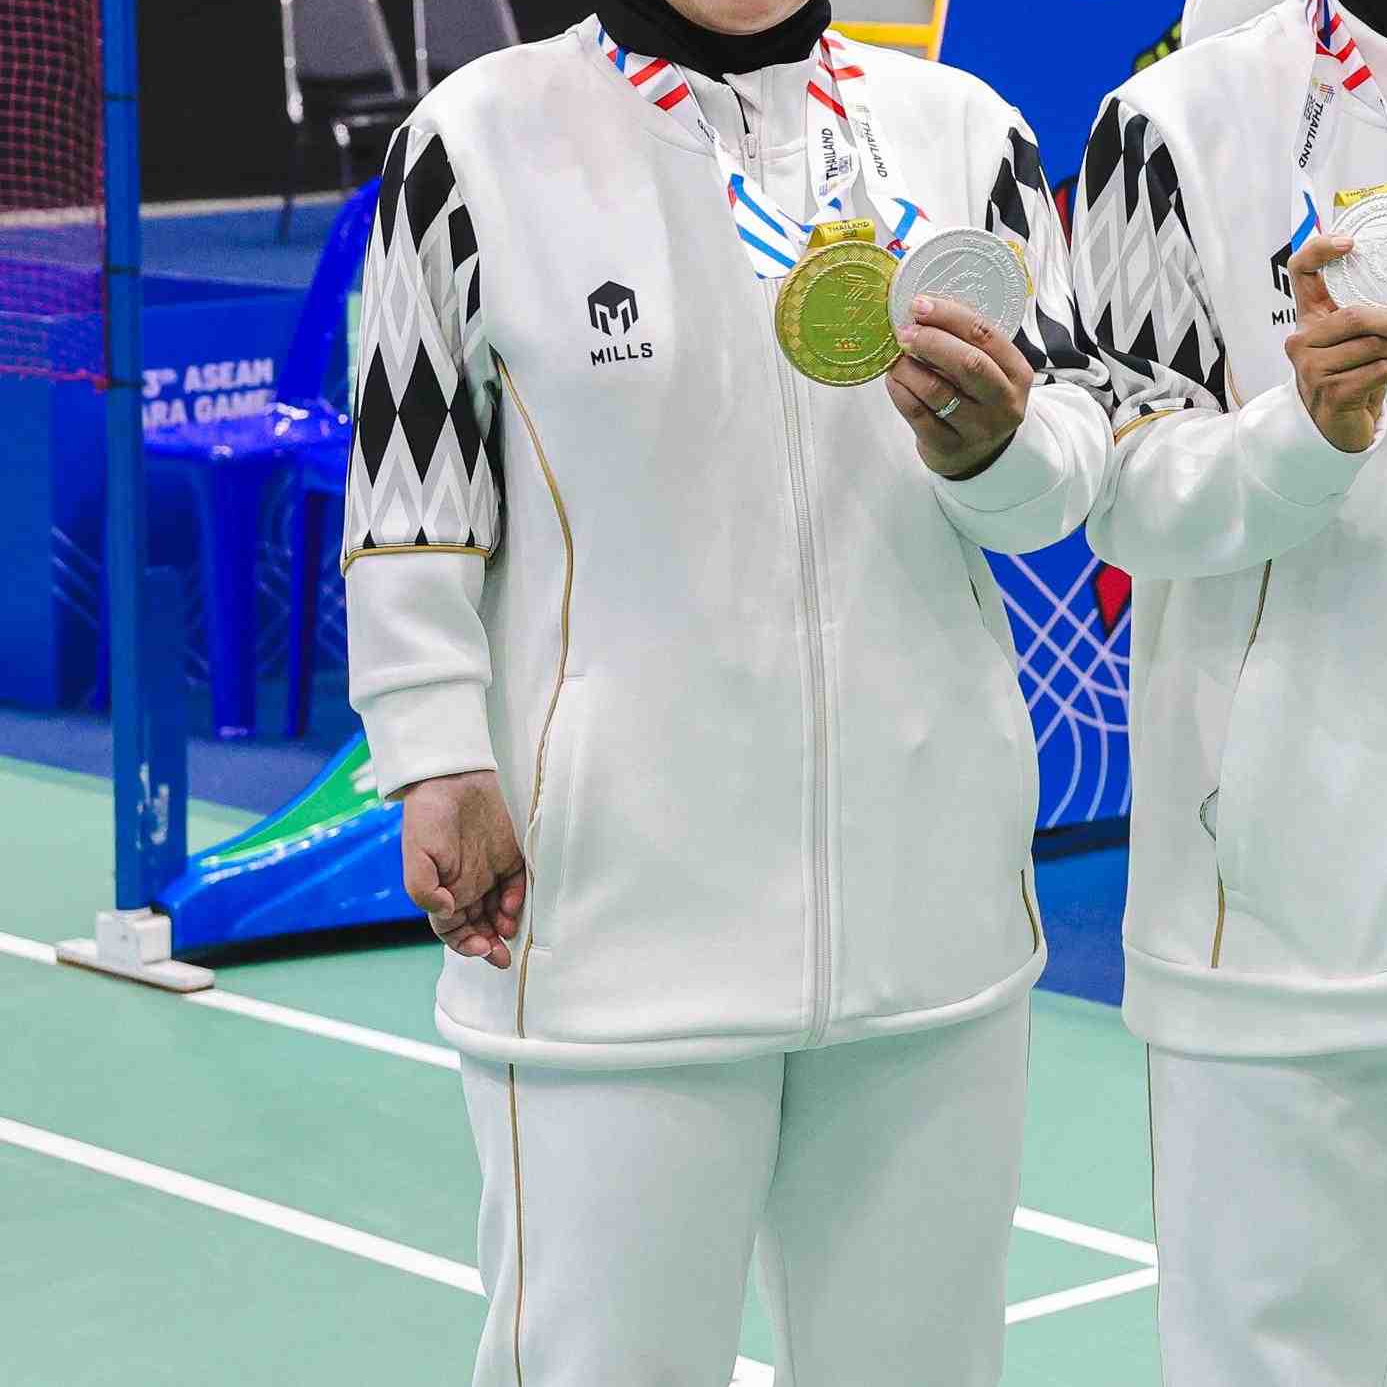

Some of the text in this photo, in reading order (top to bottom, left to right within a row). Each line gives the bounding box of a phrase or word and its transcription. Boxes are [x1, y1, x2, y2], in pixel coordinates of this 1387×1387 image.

[820, 127, 839, 181] THAILAND
[860, 121, 889, 178] THAILAND
[1297, 102, 1325, 169] THAILAND
[590, 342, 654, 366] MILLS
